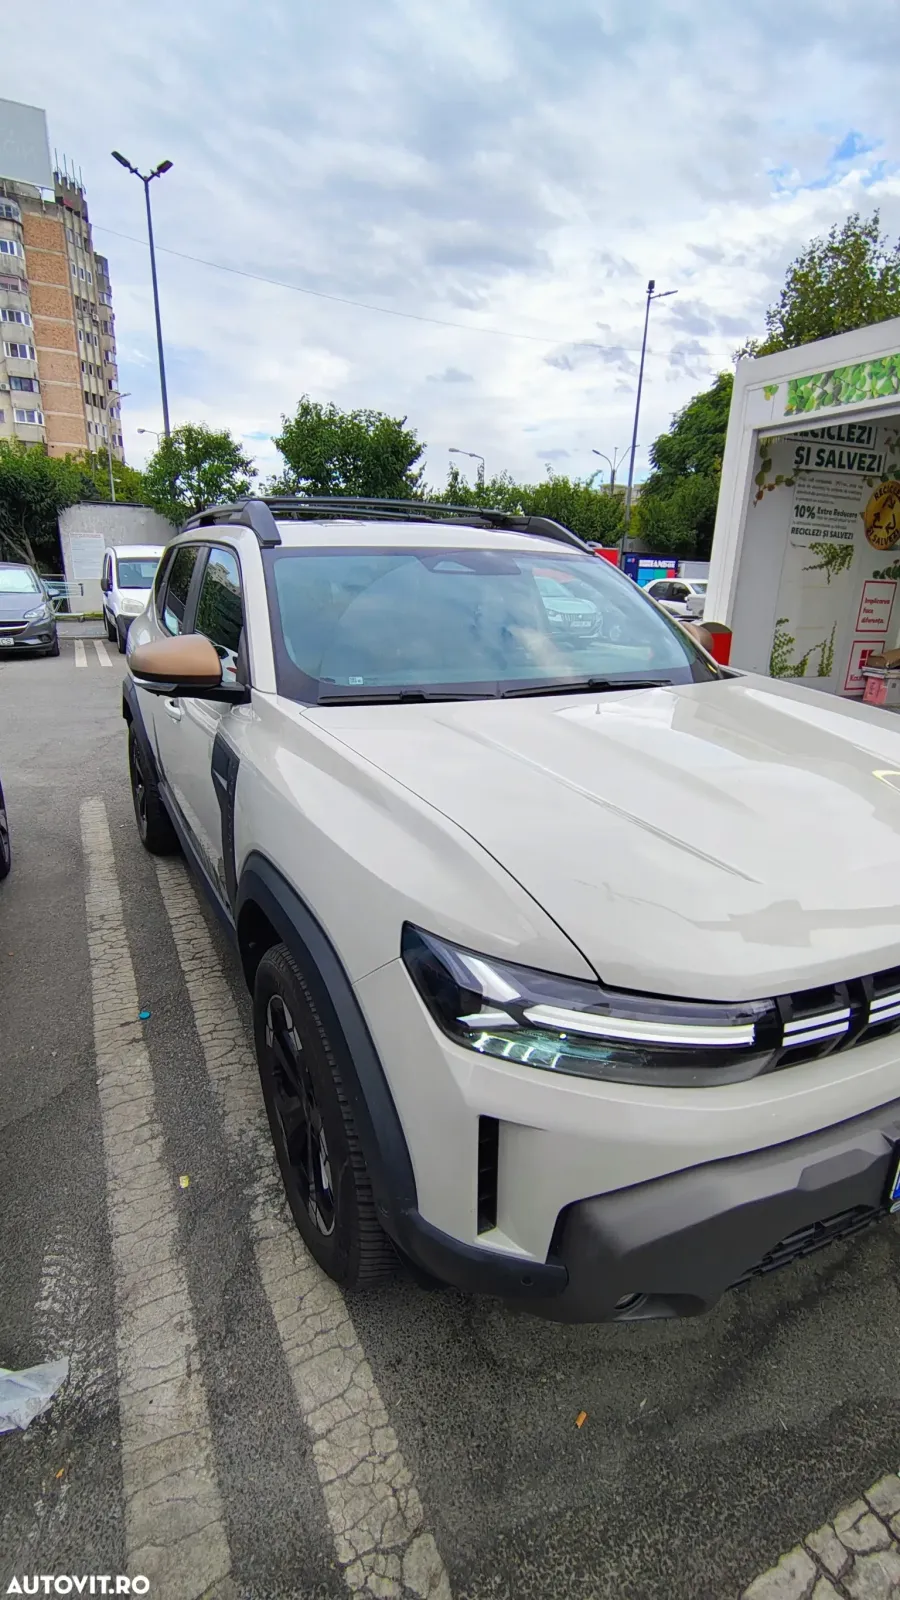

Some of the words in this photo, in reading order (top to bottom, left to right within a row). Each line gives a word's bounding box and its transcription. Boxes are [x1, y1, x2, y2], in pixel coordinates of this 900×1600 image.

[793, 424, 872, 445] CICLEZI
[815, 448, 882, 473] SALVEZI
[794, 504, 816, 520] 10%
[791, 527, 821, 537] RECICLEZI
[830, 530, 854, 540] SALVEZI
